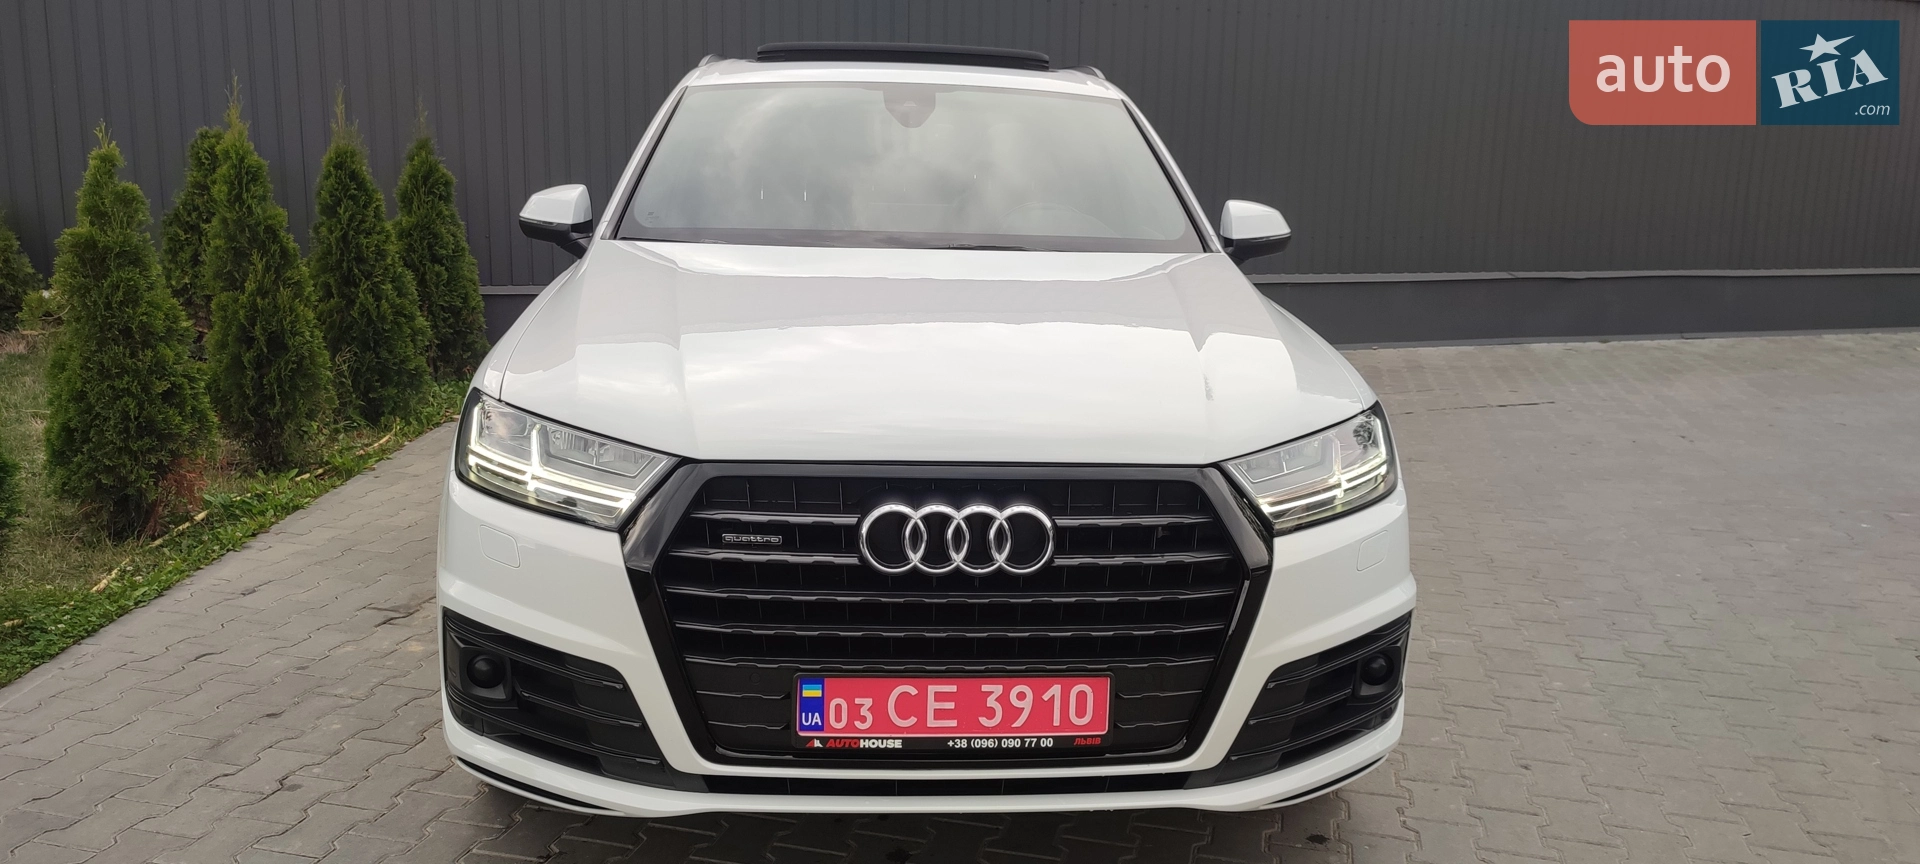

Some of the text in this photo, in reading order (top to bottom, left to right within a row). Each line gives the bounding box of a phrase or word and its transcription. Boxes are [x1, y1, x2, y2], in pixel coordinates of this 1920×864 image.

[724, 535, 780, 543] quattro
[829, 684, 1094, 730] 03 CE 3910
[802, 712, 822, 726] UA
[826, 739, 902, 748] AUTOHOUSE
[947, 738, 1054, 748] +38 (096) 090 77 00
